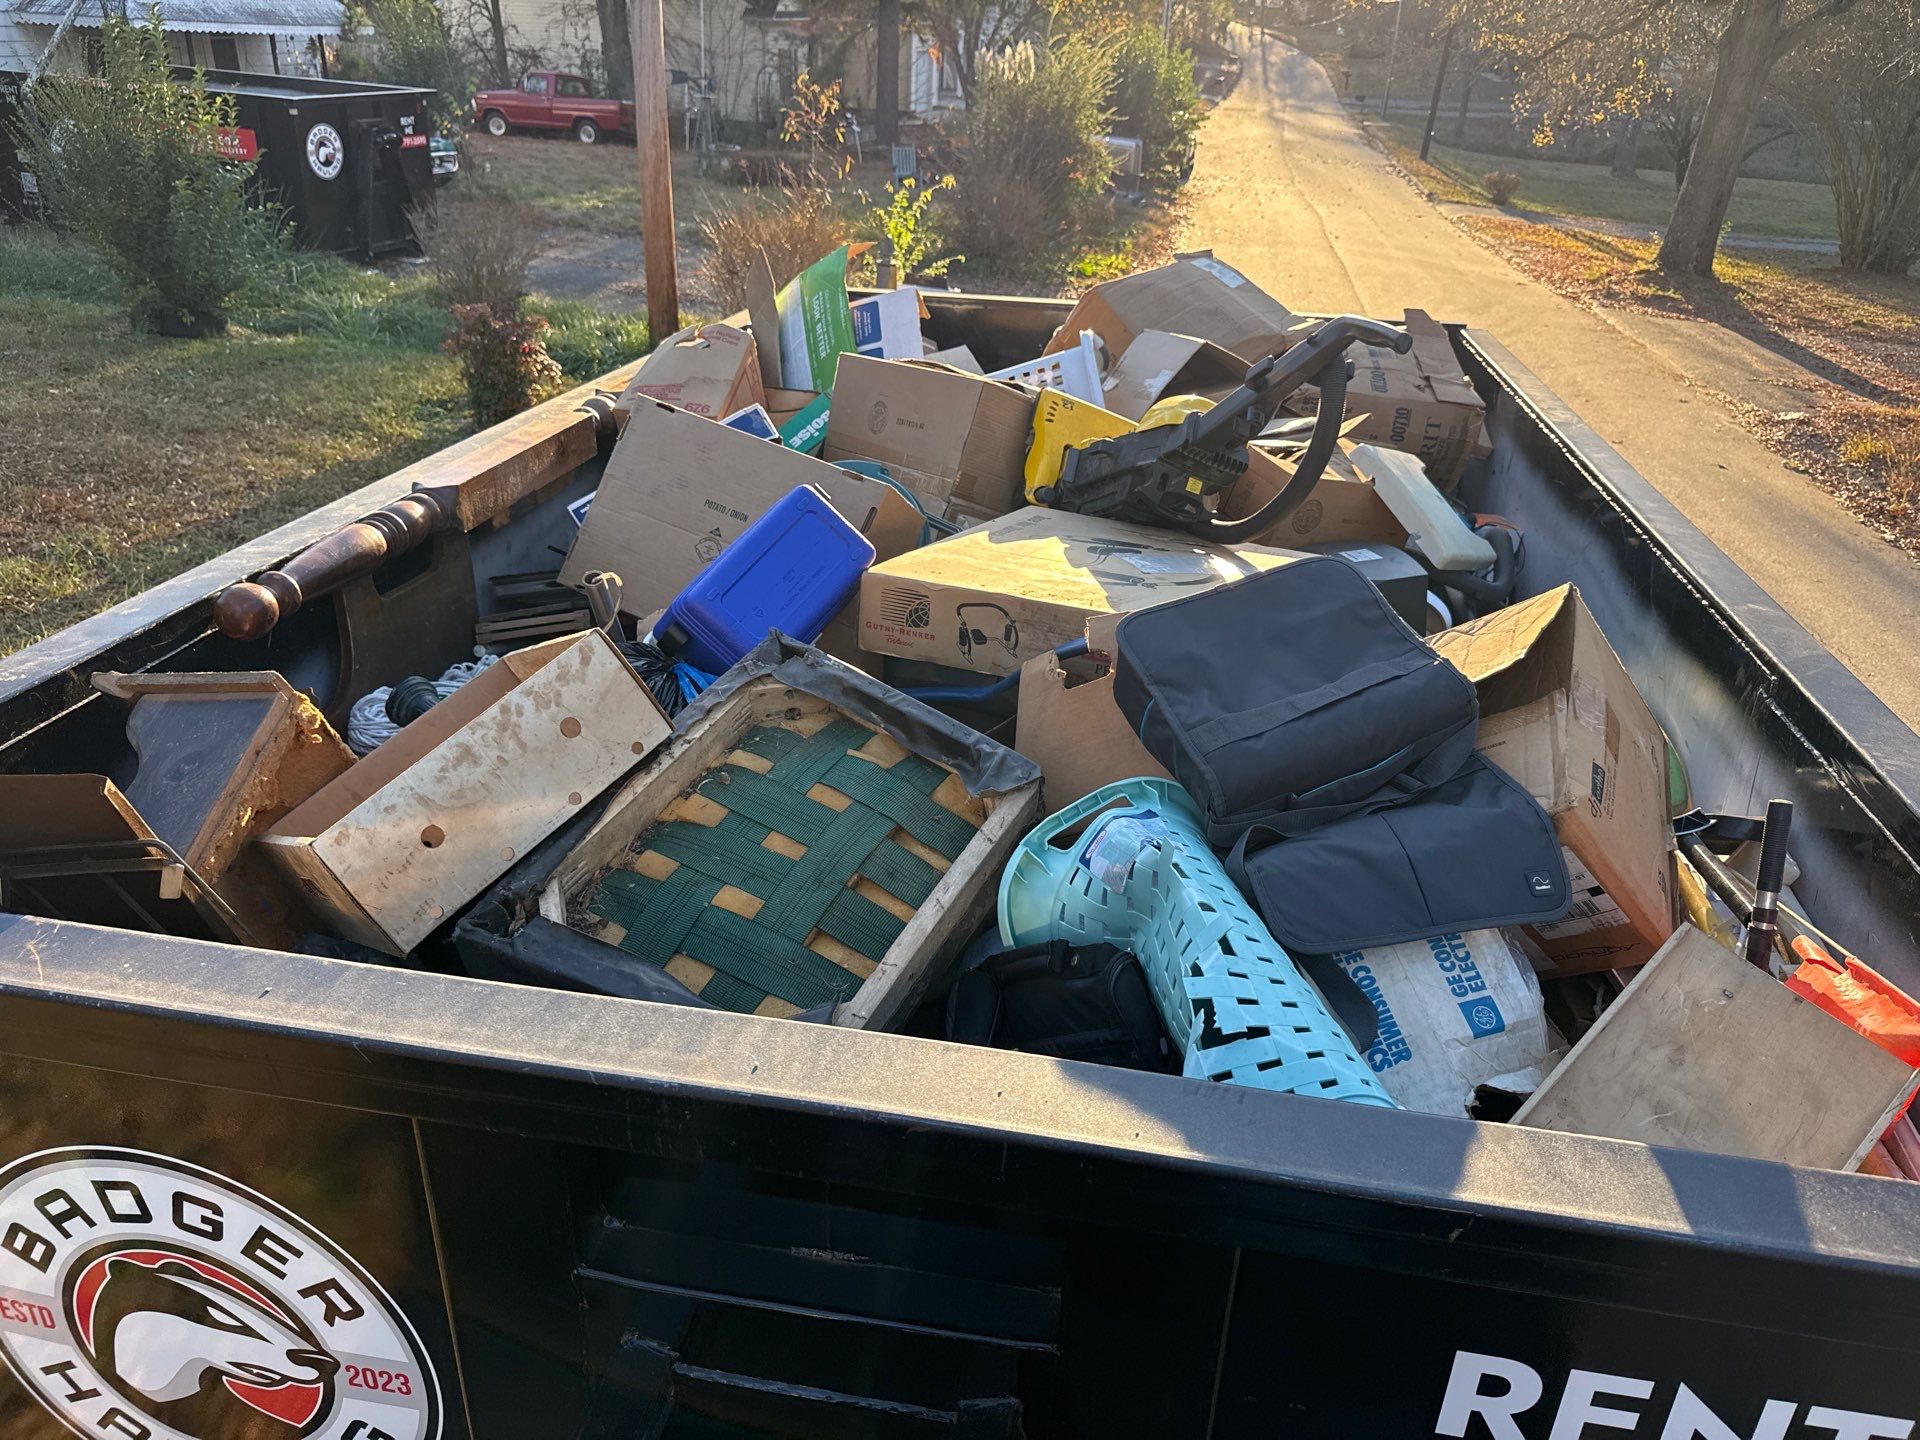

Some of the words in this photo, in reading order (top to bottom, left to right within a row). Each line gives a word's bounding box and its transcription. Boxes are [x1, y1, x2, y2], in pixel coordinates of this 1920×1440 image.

[310, 127, 339, 146] BADGER
[312, 157, 341, 176] HAULING
[811, 294, 822, 321] LOOK
[816, 322, 827, 360] BETTER
[684, 402, 712, 414] 676
[1390, 407, 1410, 442] 00710
[1420, 416, 1441, 456] RIT
[704, 499, 727, 515] POTATO
[730, 509, 749, 522] ONION
[865, 621, 936, 641] GUTHY-RENKER
[1427, 936, 1455, 972] CON
[1446, 930, 1487, 994] ELECTR
[1446, 973, 1467, 997] GE
[1, 1179, 366, 1328] BADGER
[0, 1297, 56, 1330] ESTD
[344, 1364, 413, 1397] 2023
